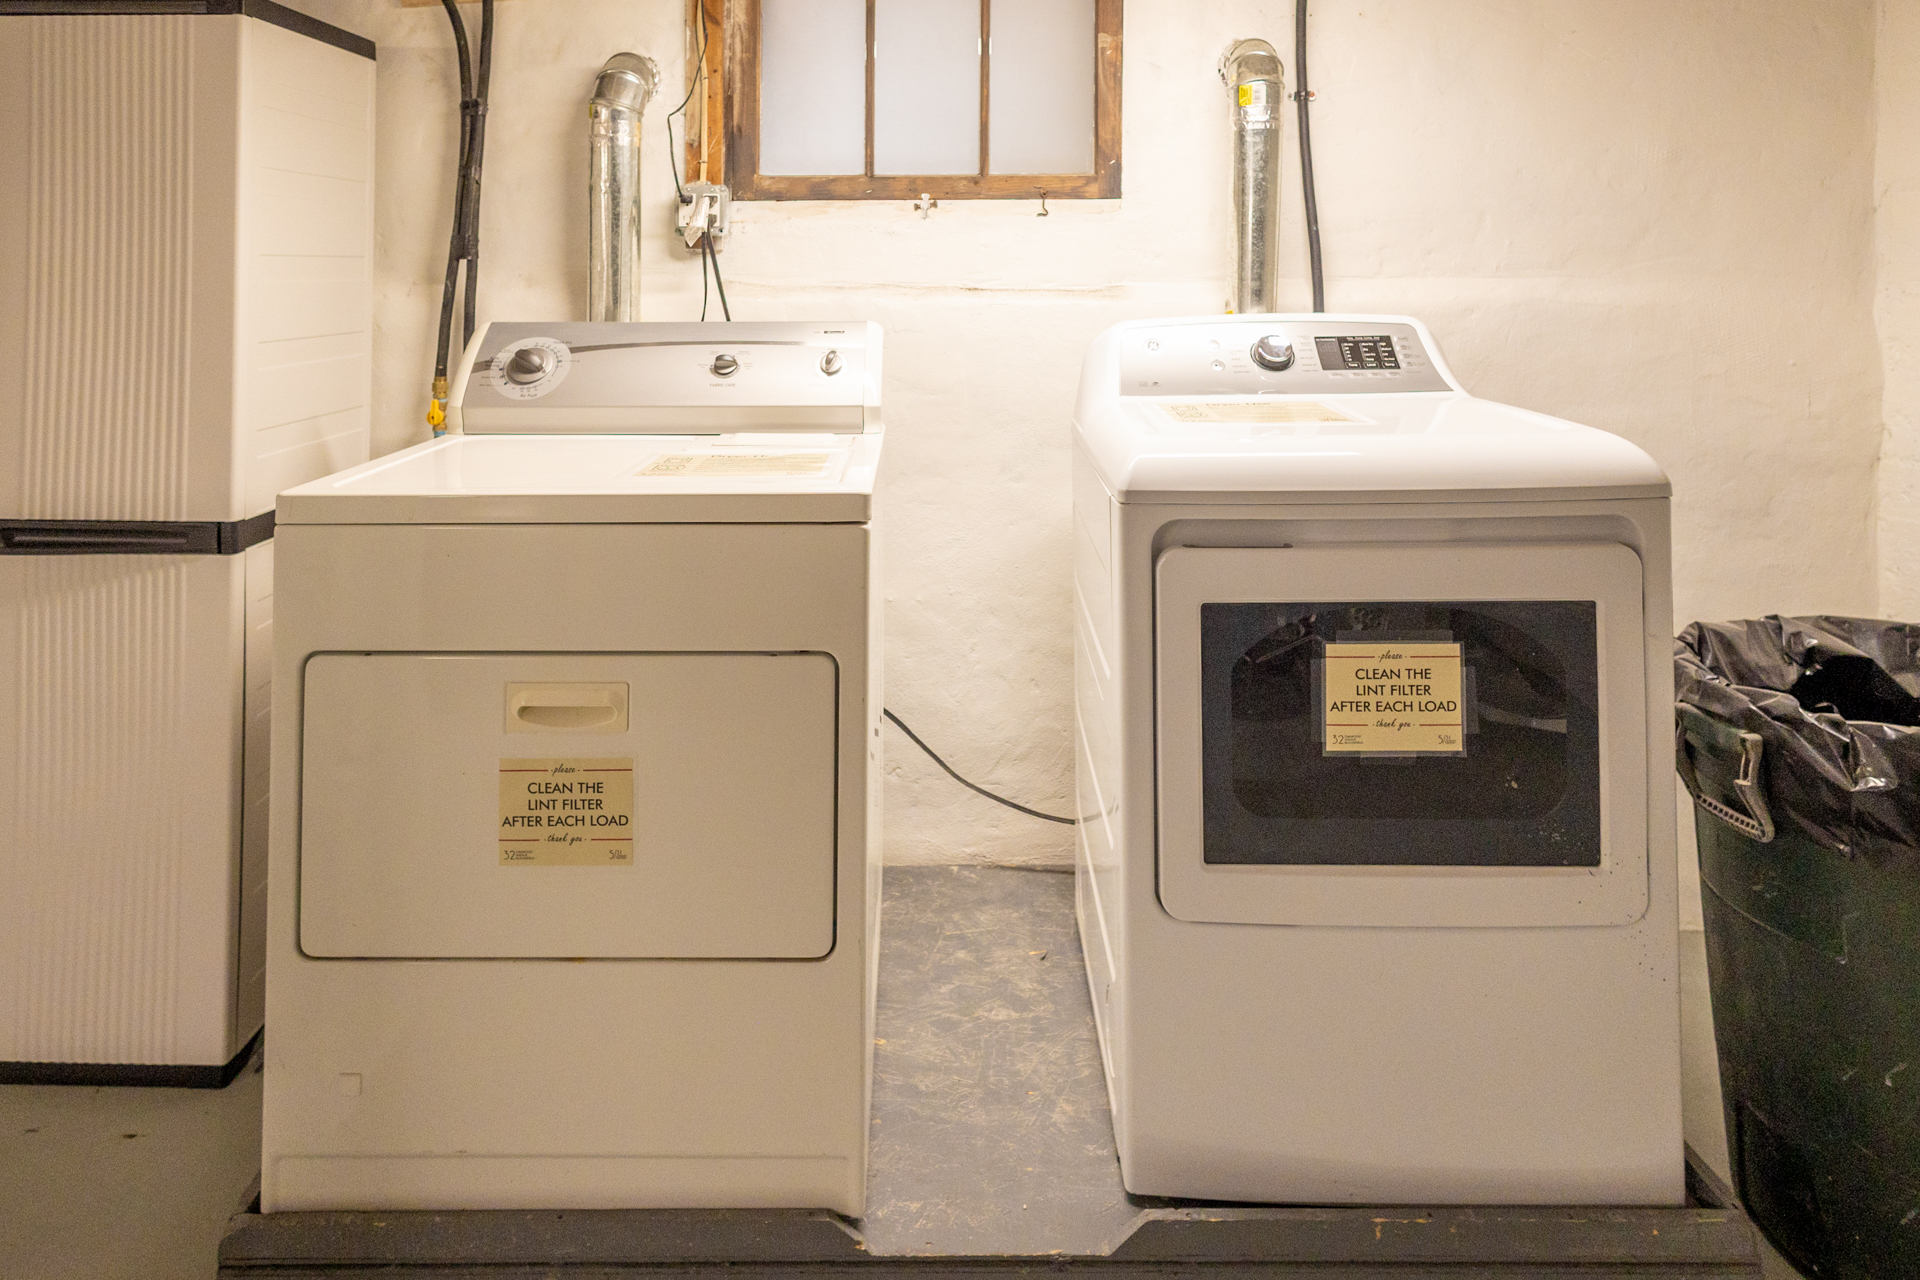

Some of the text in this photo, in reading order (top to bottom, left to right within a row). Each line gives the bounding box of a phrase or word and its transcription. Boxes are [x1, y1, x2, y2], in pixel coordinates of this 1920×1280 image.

[1379, 650, 1403, 663] please
[1355, 668, 1432, 680] CLEAN THE
[1356, 684, 1432, 696] LINT FILTER
[1330, 701, 1457, 712] AFTER EACH LOAD
[1375, 718, 1411, 731] thank you
[1332, 734, 1344, 745] 32
[551, 763, 576, 777] please
[527, 782, 604, 794] CLEAN THE
[528, 799, 604, 811] LINT FILTER
[502, 815, 629, 827] AFTER EACH LOAD
[547, 832, 583, 846] thank you
[503, 849, 516, 860] 32
